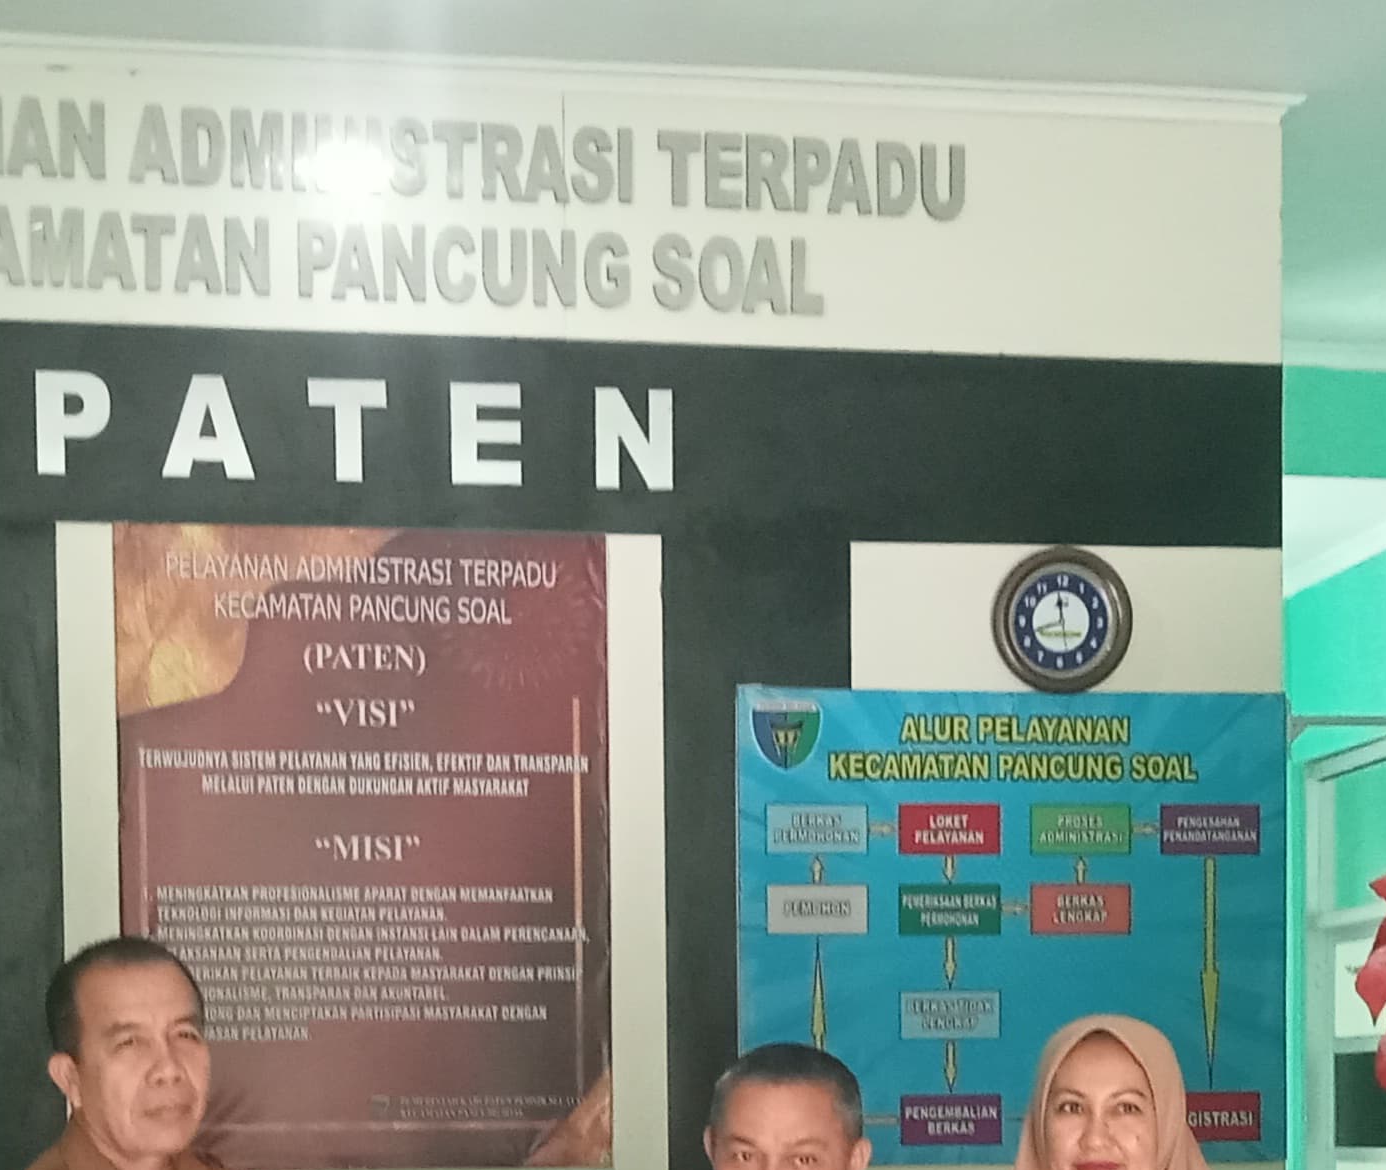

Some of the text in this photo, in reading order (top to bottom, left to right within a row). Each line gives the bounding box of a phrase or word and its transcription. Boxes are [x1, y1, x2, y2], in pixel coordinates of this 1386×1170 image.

[657, 127, 966, 222] TERPADU
[297, 219, 632, 309] PANCUNG
[652, 232, 824, 317] SOAL
[33, 369, 674, 491] PATEN
[165, 550, 557, 588] PELAYANAN ADMINISTRASI TERPADU
[1037, 583, 1047, 595] 11
[1057, 574, 1069, 588] 12
[1079, 582, 1085, 594] 1
[213, 592, 512, 624] KECAMATAN PANCUNG SOAL
[1025, 596, 1036, 608] 10
[303, 643, 427, 675] (PATEN)
[900, 714, 1130, 744] ALUR PELAYANAN
[139, 748, 589, 774] TERWUJUDNYA SISTEM PELAYANAN YANG EFISIEN, EFEKTIF DAN TRANSPARAN
[828, 752, 1198, 782] KECAMATAN PANCUNG SOAL
[201, 774, 529, 797] MELALUI PATEN DENGAN DUKUNGAN AKTIF MASYARAKAT
[791, 814, 841, 827] BERKAS
[929, 814, 969, 829] LOKET
[1057, 814, 1103, 828] PROSES
[774, 829, 860, 844] PERMOHONAN
[915, 829, 984, 845] PELAYANAN
[1039, 829, 1123, 844] ADMINISTRASI
[157, 885, 249, 902] MENINGKATKAN
[252, 885, 360, 902] PROFESIONALISME
[364, 886, 407, 903] APARAT
[410, 886, 457, 903] DENGAN
[460, 886, 553, 904] MEMANFAATKAN
[963, 894, 997, 910] BERKAS
[1057, 894, 1105, 908] BERKAS
[156, 905, 221, 921] TEKNOLOGI
[224, 905, 290, 922] INFORMASI
[294, 905, 317, 922] DAN
[321, 905, 376, 922] KEGIATAN
[783, 900, 851, 917] PEMOHON
[921, 911, 980, 926] PERMOHONAN
[1052, 909, 1108, 925] LENGKAP
[157, 926, 249, 942] MENINGKATKAN
[253, 926, 323, 942] KOORDINASI
[327, 926, 373, 942] DENGAN
[376, 926, 428, 942] INSTANSI
[431, 926, 457, 942] LAIN
[460, 926, 501, 942] DALAM
[244, 946, 280, 961] SERTA
[284, 946, 371, 961] PENGENDALIAN
[241, 966, 307, 981] PELAYANAN
[311, 966, 360, 981] TERBAIK
[364, 966, 408, 982] KEPADA
[410, 966, 485, 982] MASYARAKAT
[488, 966, 534, 982] DENGAN
[275, 985, 350, 1001] TRANSPARAN
[354, 985, 377, 1001] DAN
[237, 1005, 260, 1021] DAN
[264, 1005, 347, 1021] MENCIPTAKAN
[424, 1005, 499, 1021] MASYARAKAT
[501, 1005, 548, 1021] DENGAN
[904, 1105, 998, 1120] PENGEMBALIAN
[1187, 1110, 1253, 1127] GISTRASI
[927, 1121, 975, 1135] BERKAS
